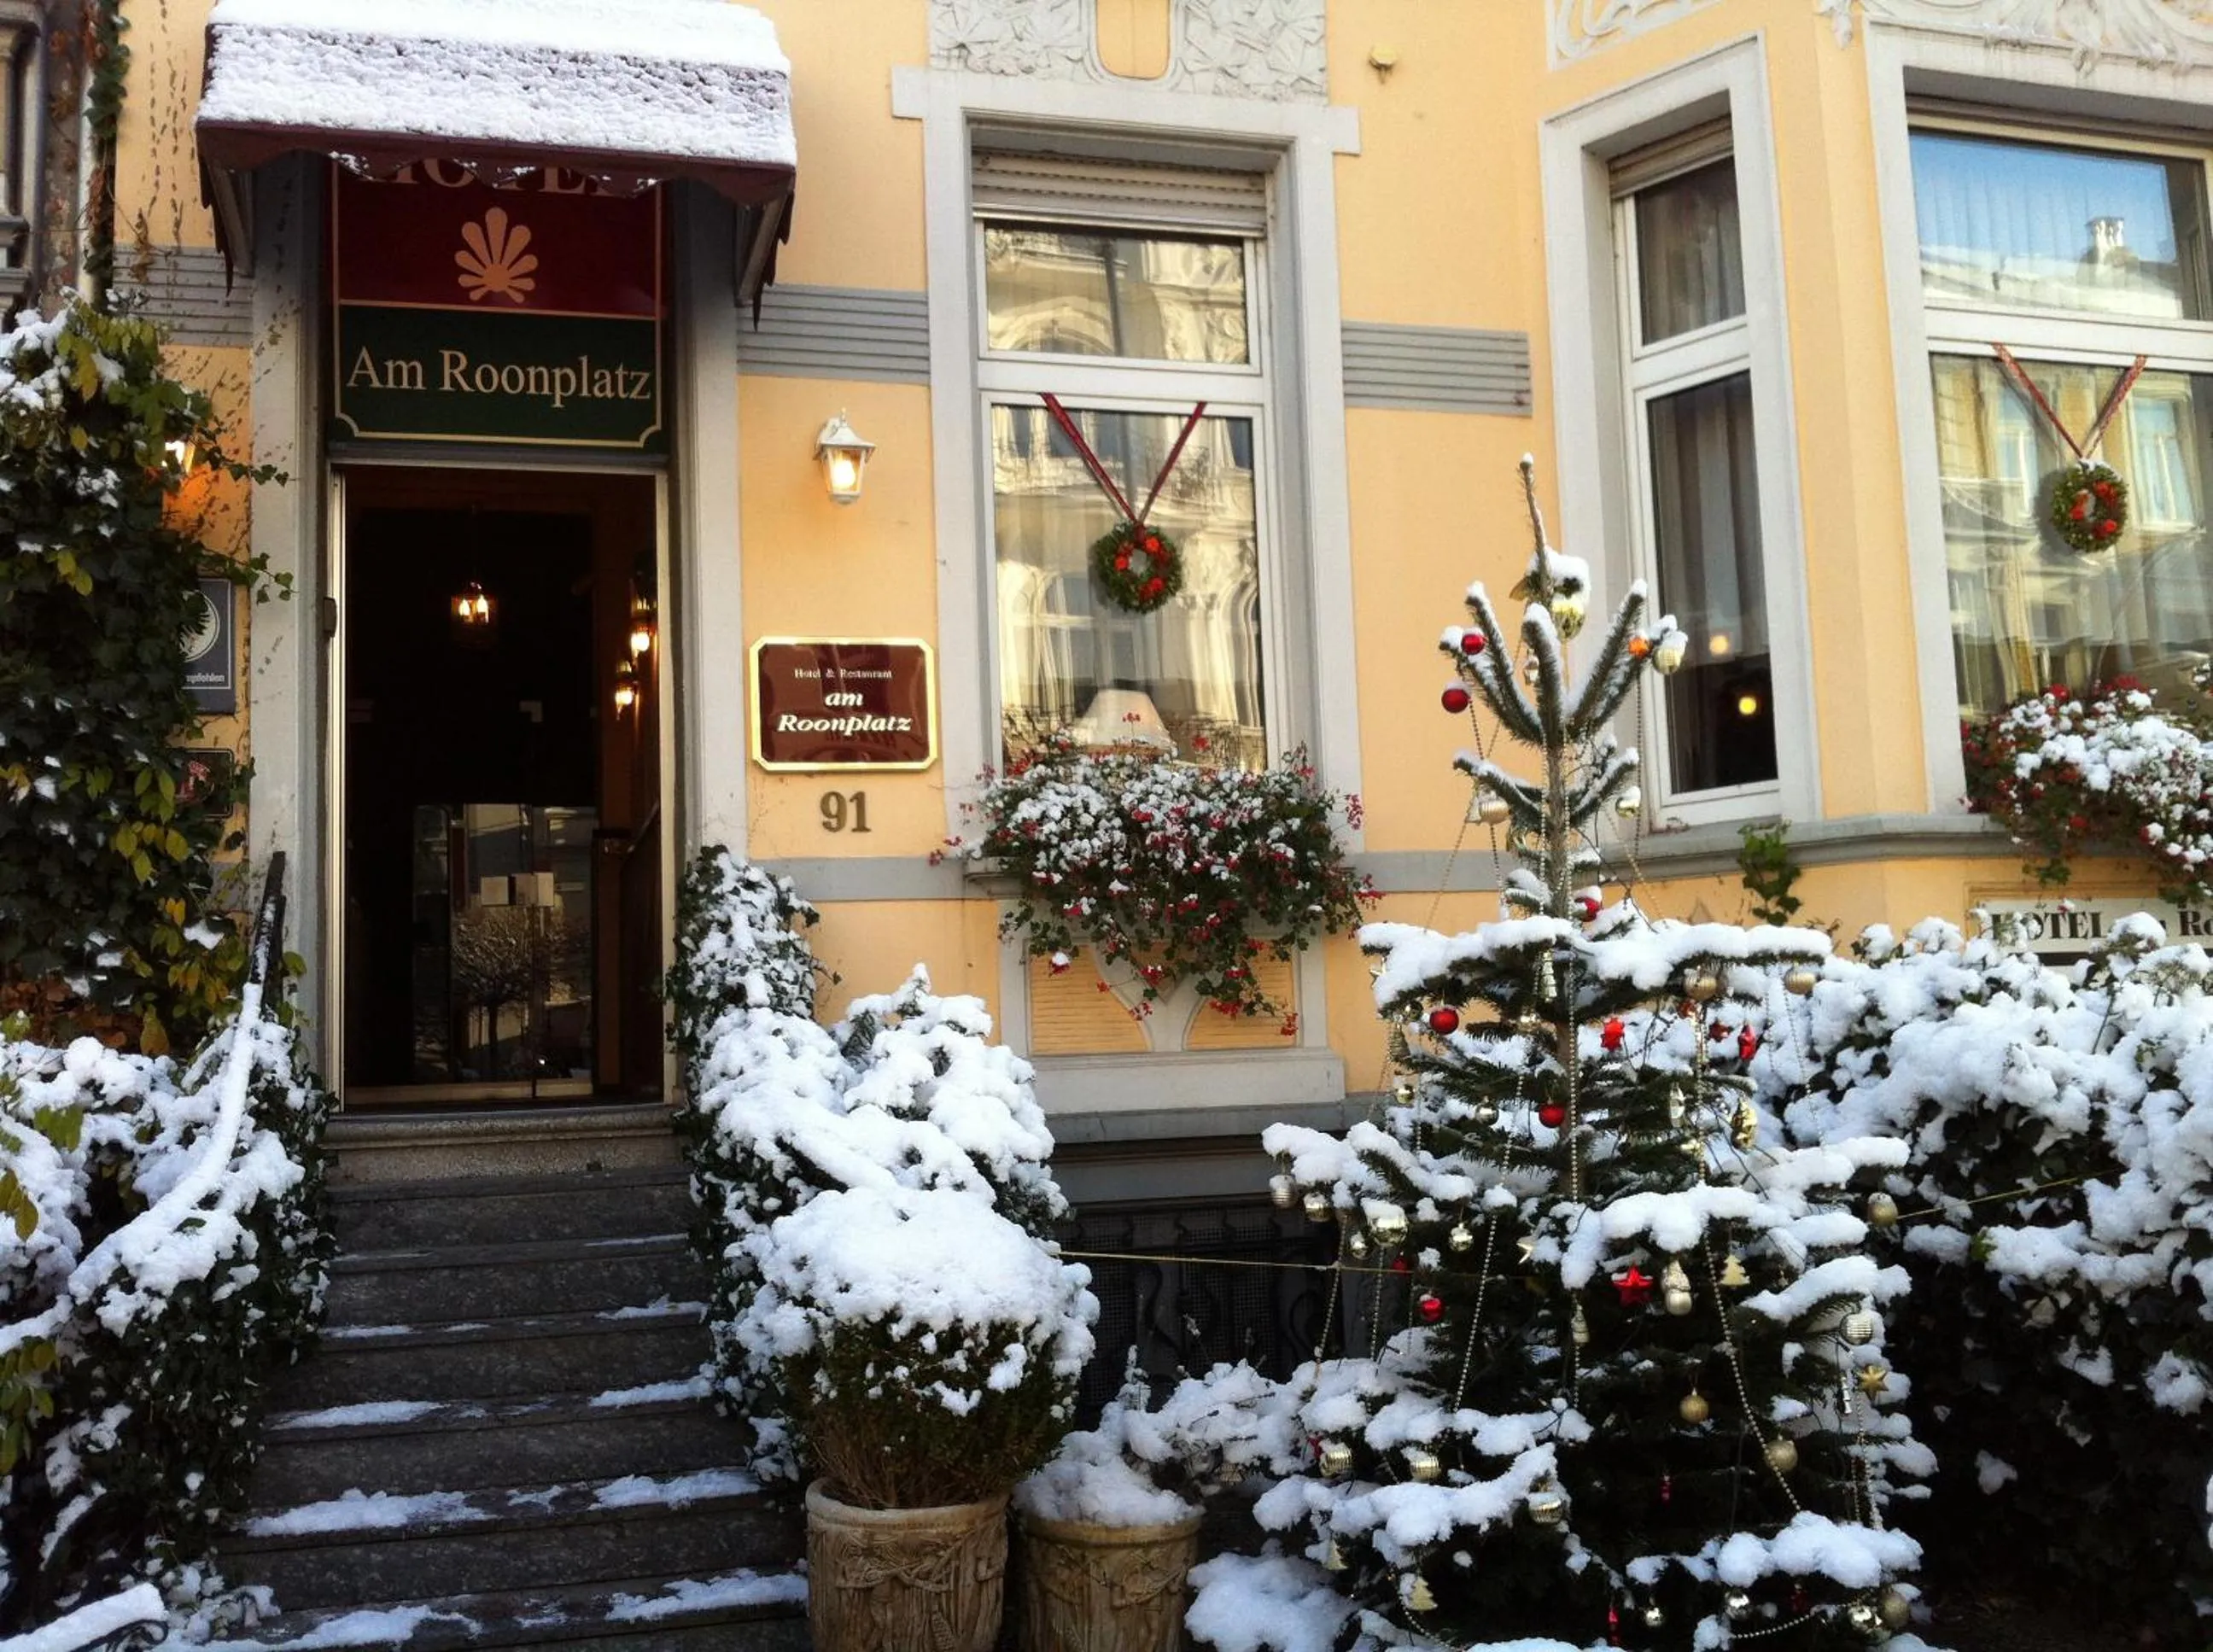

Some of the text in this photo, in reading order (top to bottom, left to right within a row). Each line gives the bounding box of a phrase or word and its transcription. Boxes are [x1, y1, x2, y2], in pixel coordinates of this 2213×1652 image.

[347, 346, 651, 408] Am Roonplatz
[795, 668, 892, 679] Hotel & Restaurant
[825, 692, 863, 707] am
[779, 714, 912, 736] Roonplatz
[820, 791, 871, 833] 91
